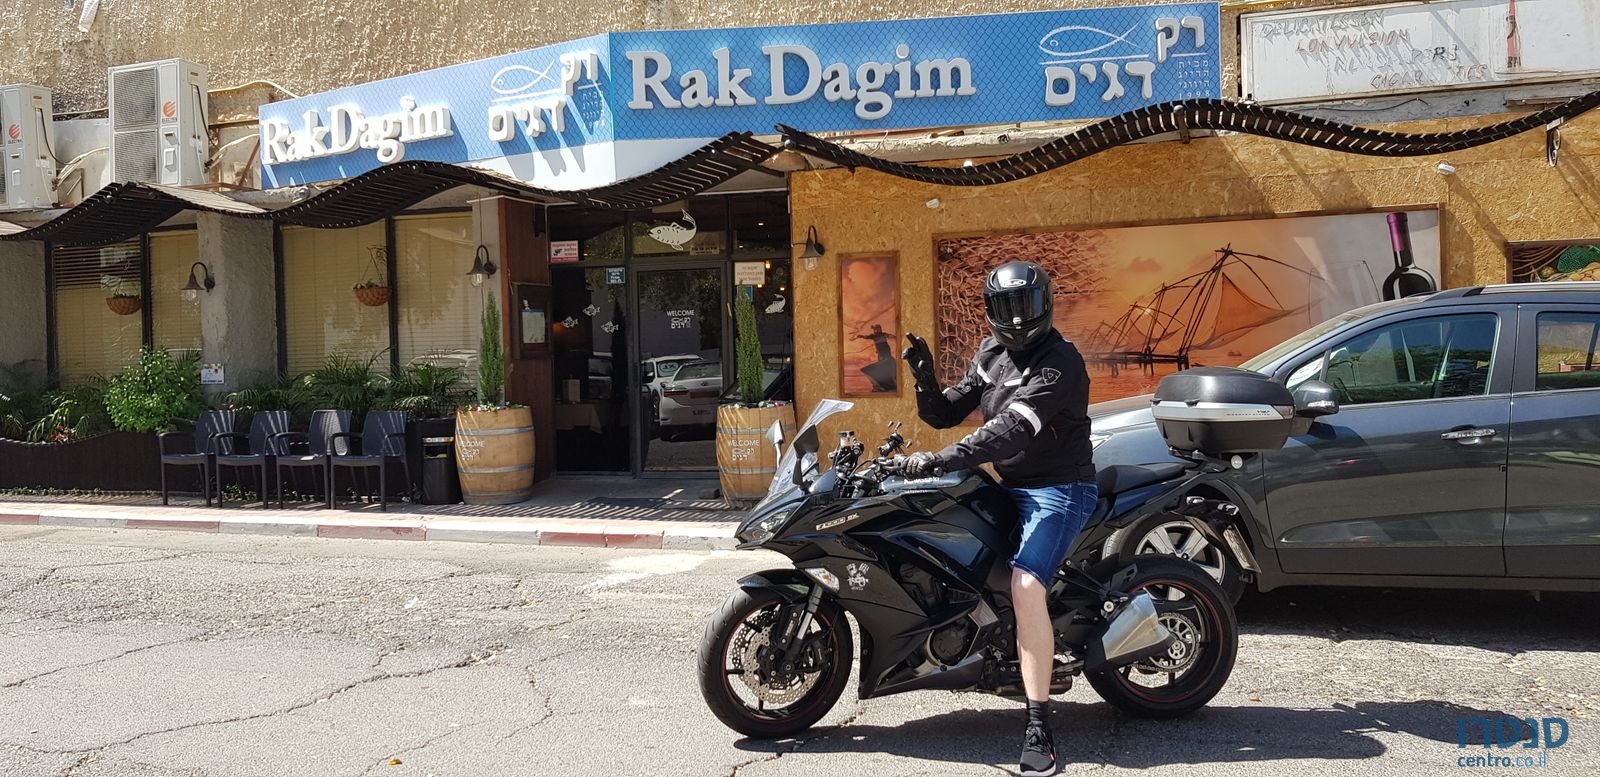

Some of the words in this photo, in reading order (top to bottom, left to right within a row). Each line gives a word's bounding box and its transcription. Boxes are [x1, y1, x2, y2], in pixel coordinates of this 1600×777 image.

[1155, 16, 1206, 63] רק
[560, 51, 599, 96] רק
[625, 47, 755, 110] Rak
[763, 43, 976, 121] Dagim
[1045, 61, 1156, 107] דגים
[1178, 60, 1209, 69] מבית
[1179, 90, 1211, 100] 1998
[262, 109, 331, 165] Rak
[329, 96, 454, 162] Dagim
[488, 97, 567, 142] דגים
[727, 439, 760, 447] WELCOME
